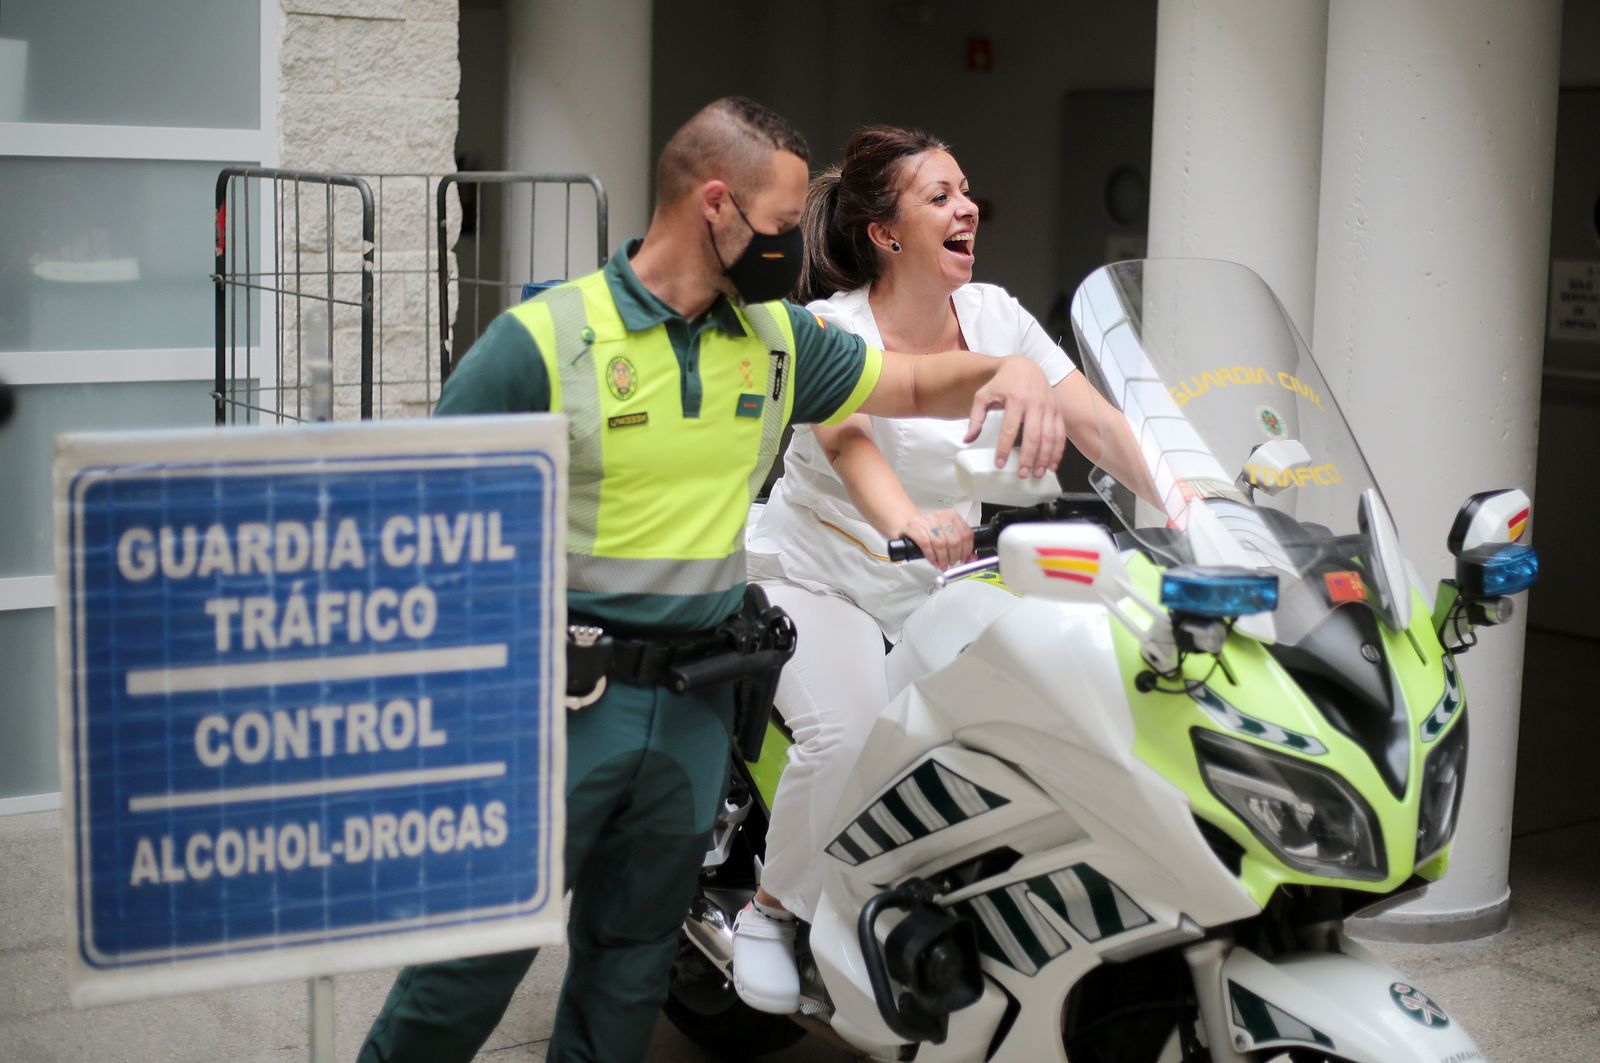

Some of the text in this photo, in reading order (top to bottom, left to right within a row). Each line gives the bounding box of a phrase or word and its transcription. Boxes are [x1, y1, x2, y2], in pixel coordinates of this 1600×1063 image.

[1169, 367, 1325, 412] GUARDIA CIVIL
[1243, 463, 1342, 488] TRAFICO
[117, 513, 515, 581] GUARDIA CIVIL
[206, 581, 437, 652] TRÁFICO
[195, 699, 446, 767] CONTROL
[131, 801, 508, 885] ALCOHOL-DROGAS
